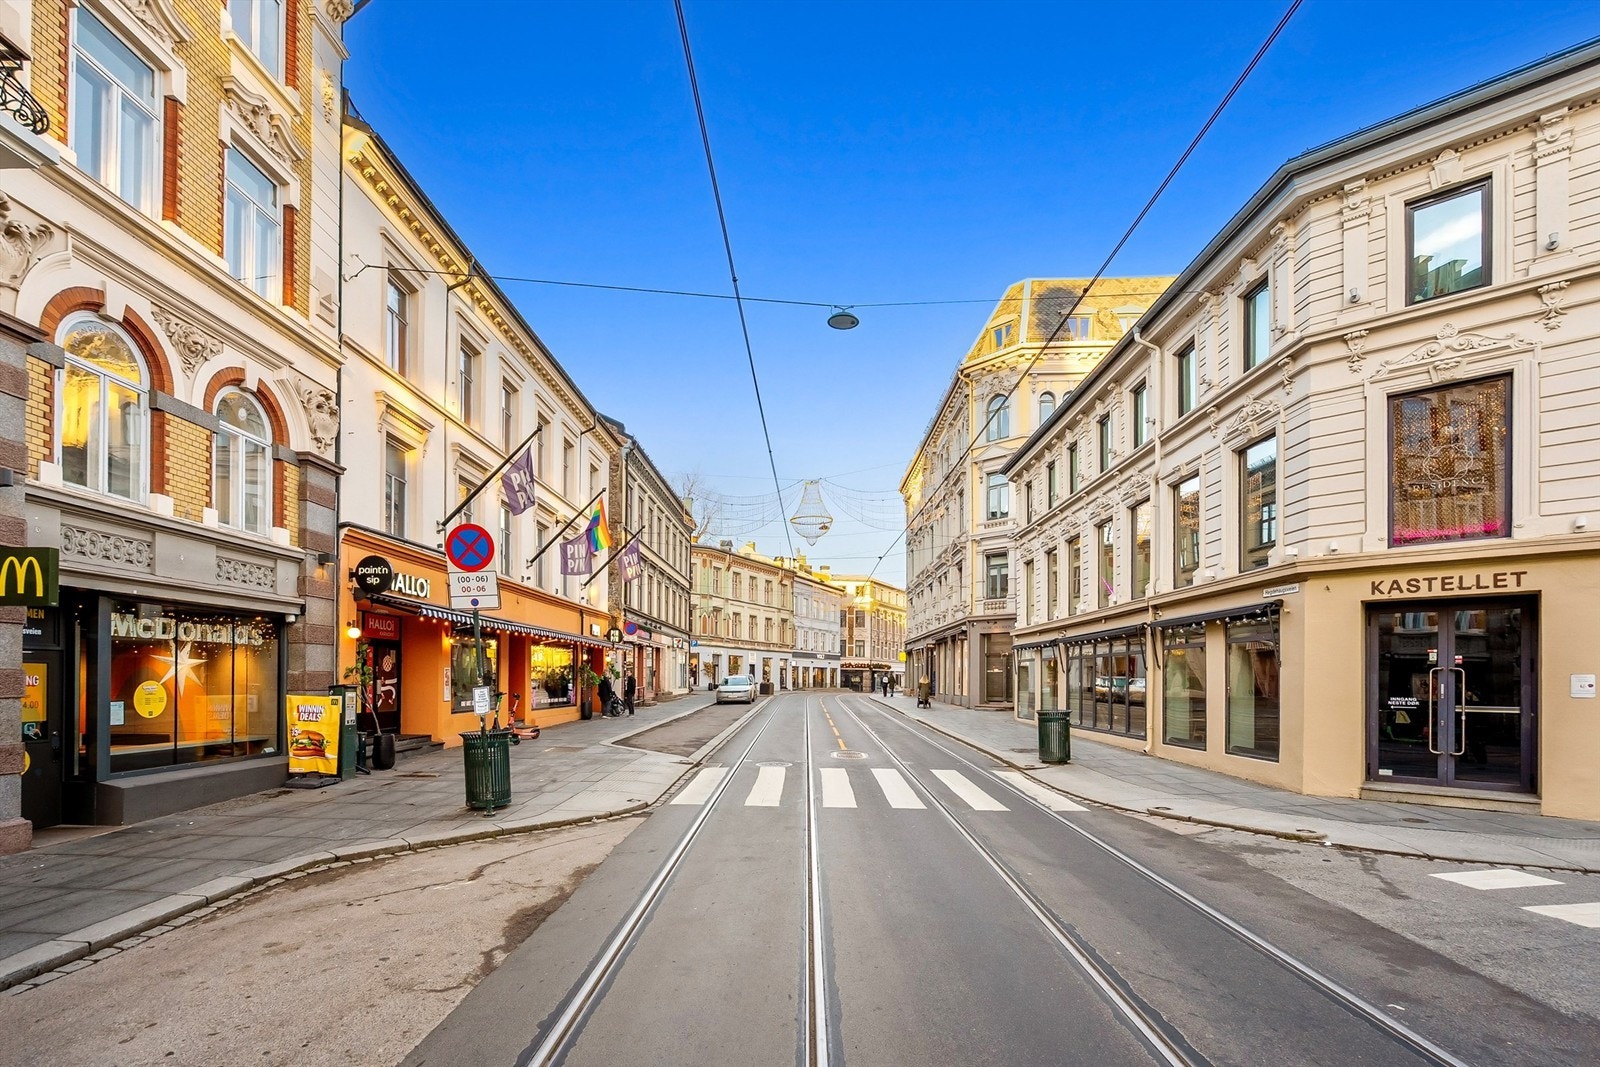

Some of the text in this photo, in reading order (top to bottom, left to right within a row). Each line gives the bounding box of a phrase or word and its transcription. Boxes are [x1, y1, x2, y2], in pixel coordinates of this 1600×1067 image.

[567, 544, 586, 559] PIN
[623, 552, 638, 567] PIN
[358, 565, 388, 575] paint'n
[567, 558, 585, 573] PIN
[626, 564, 642, 579] PIN
[366, 575, 380, 585] sip
[391, 573, 430, 598] ALLOi
[1370, 571, 1528, 596] KASTELLET
[27, 609, 45, 619] MEN
[22, 627, 42, 636] sveien
[25, 675, 39, 686] NG
[22, 701, 39, 709] 4.00
[298, 713, 322, 722] DEALS
